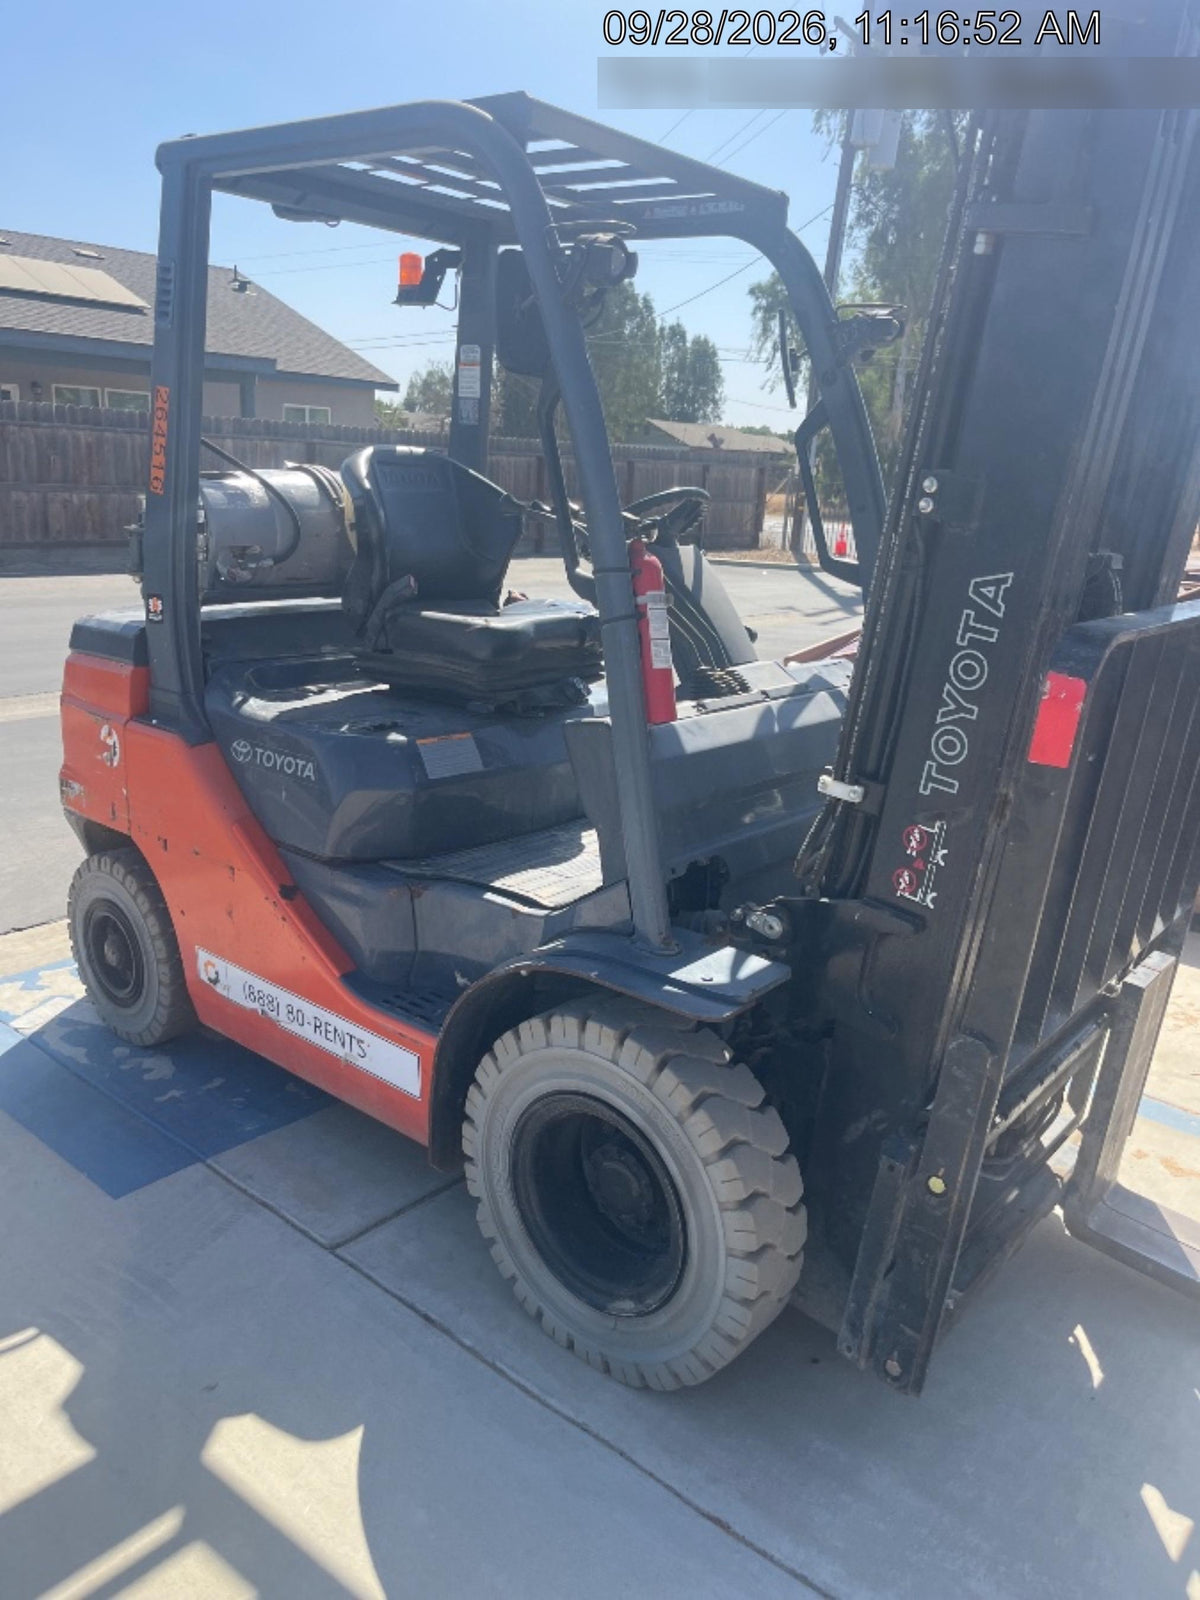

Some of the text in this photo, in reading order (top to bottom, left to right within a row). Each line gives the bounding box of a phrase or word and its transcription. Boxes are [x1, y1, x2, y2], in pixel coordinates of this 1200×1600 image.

[919, 572, 1014, 795] TOYOTA
[255, 747, 315, 781] TOYOTA
[286, 1003, 368, 1059] 80-RENTS
